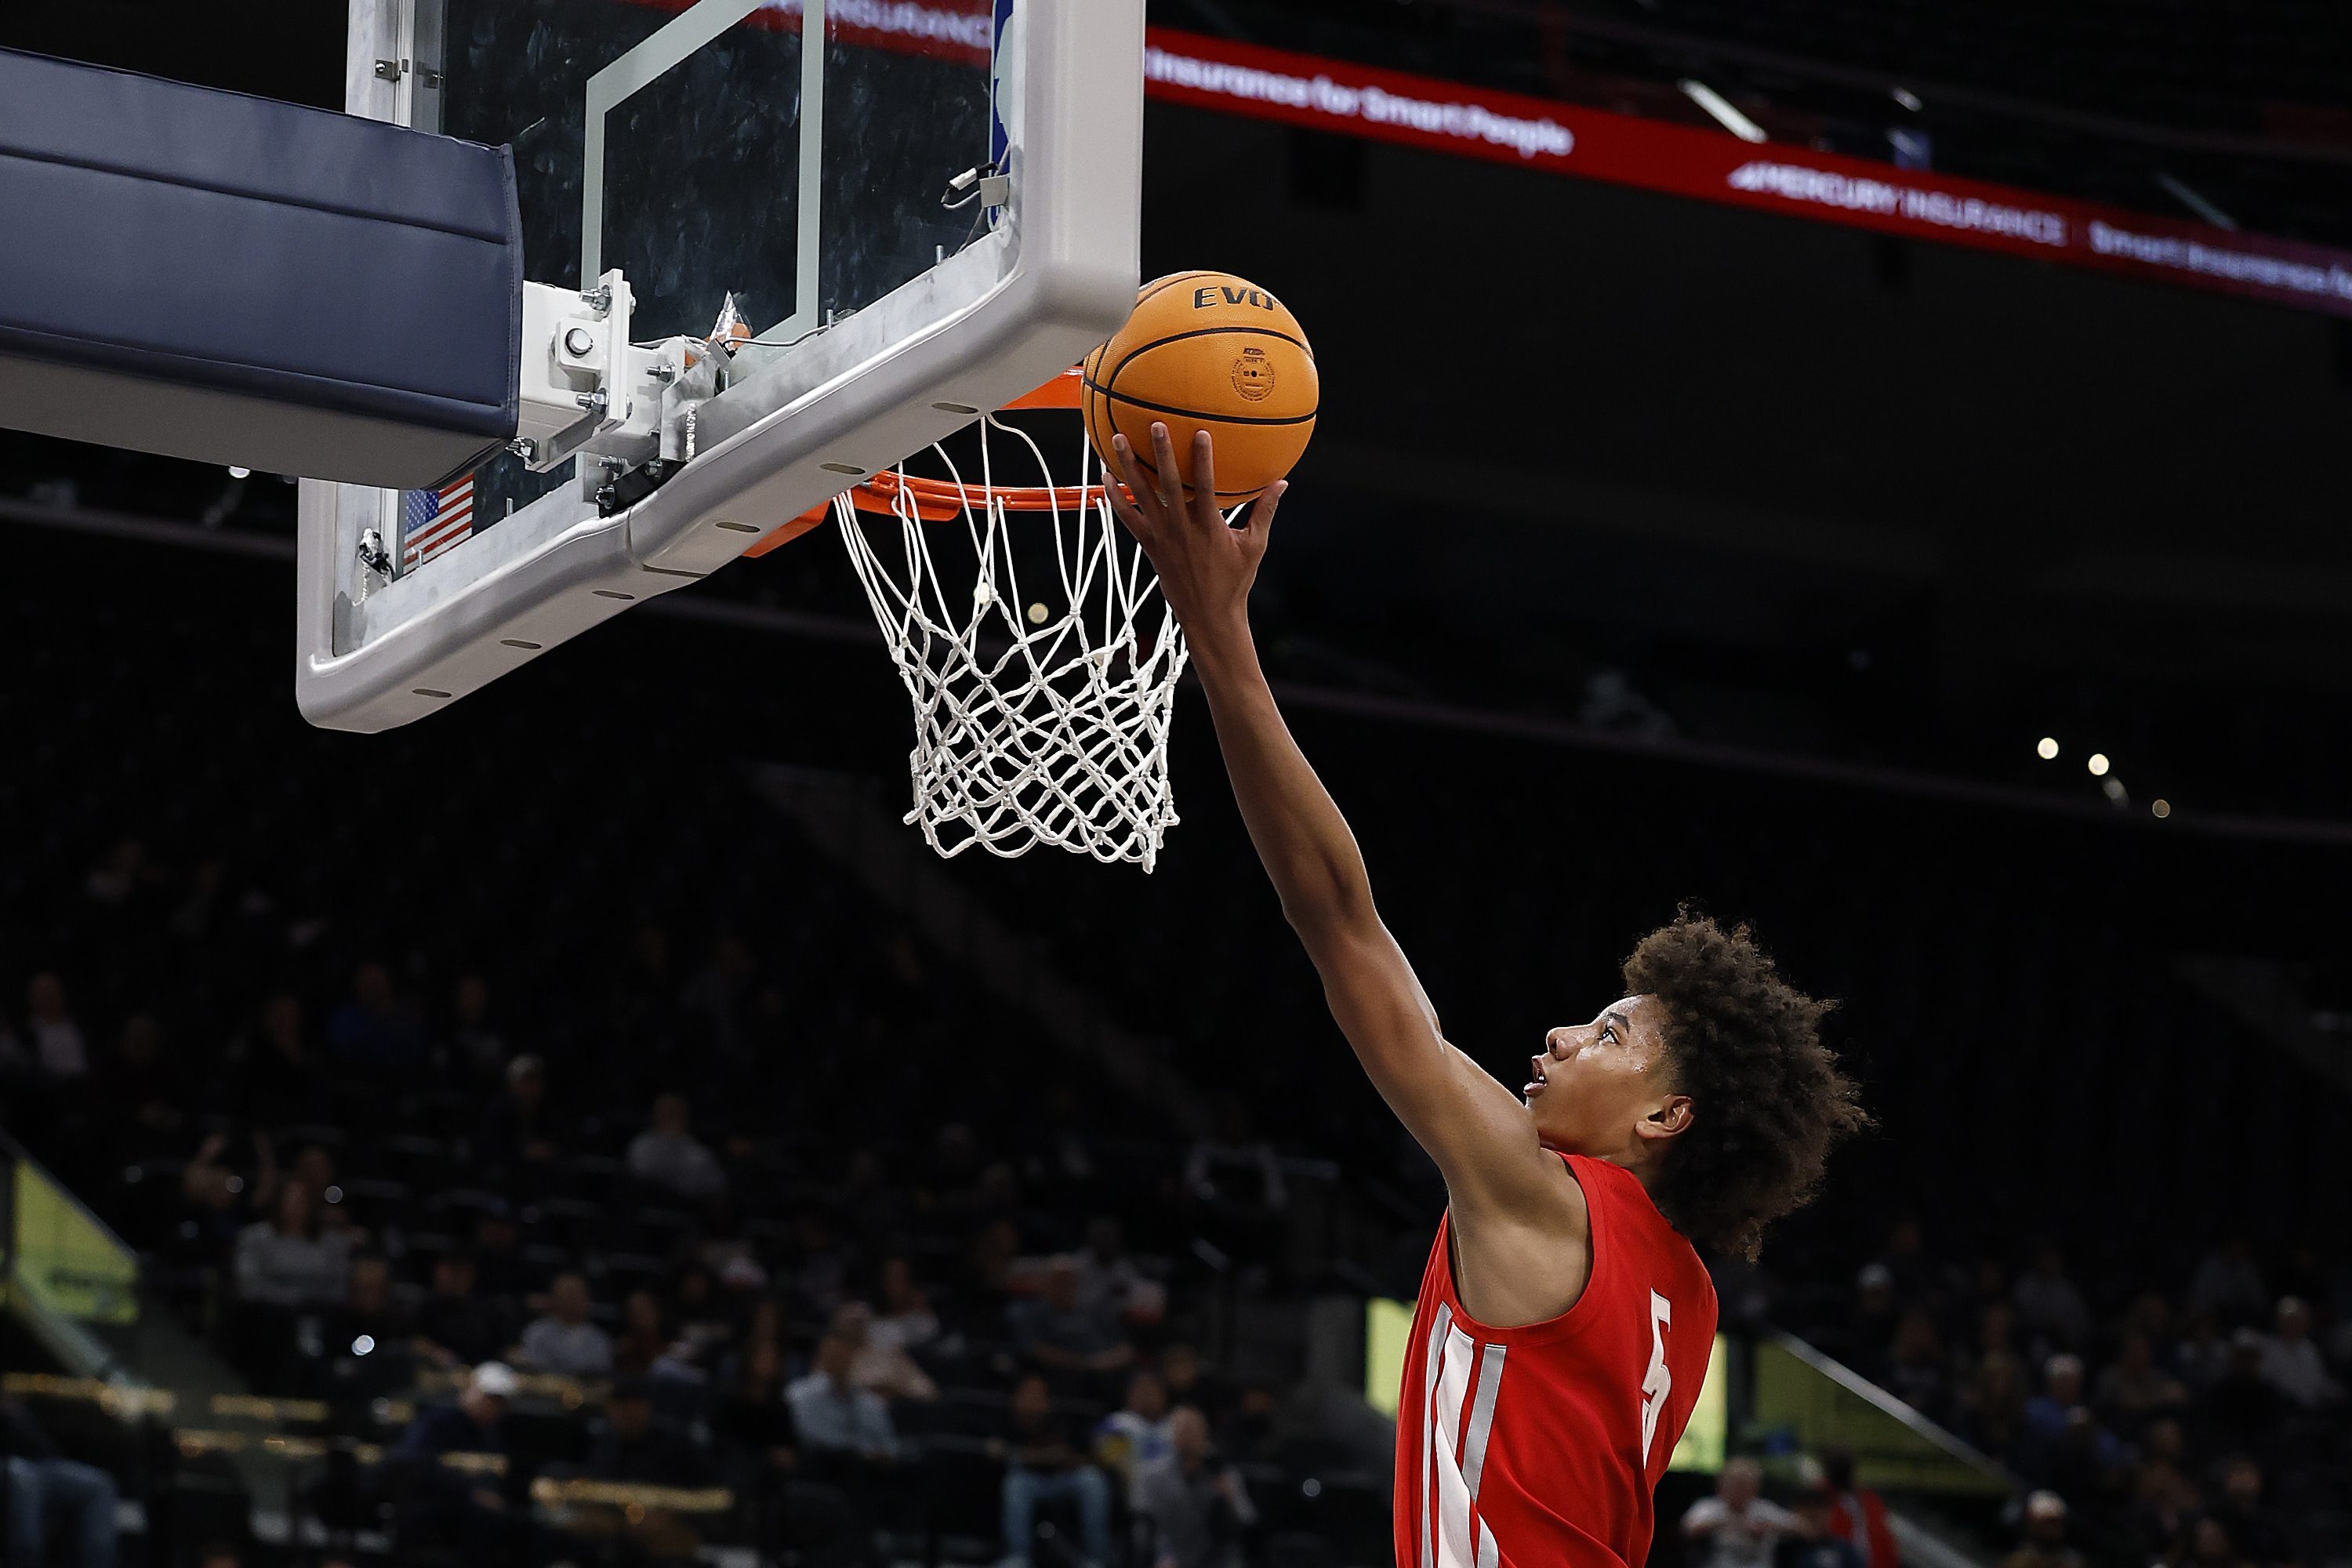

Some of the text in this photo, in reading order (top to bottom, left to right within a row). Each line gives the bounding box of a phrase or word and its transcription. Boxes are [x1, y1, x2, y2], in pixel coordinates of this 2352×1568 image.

[1464, 103, 1575, 159] People
[1194, 286, 1274, 311] EVO
[1642, 1287, 1671, 1470] 5
